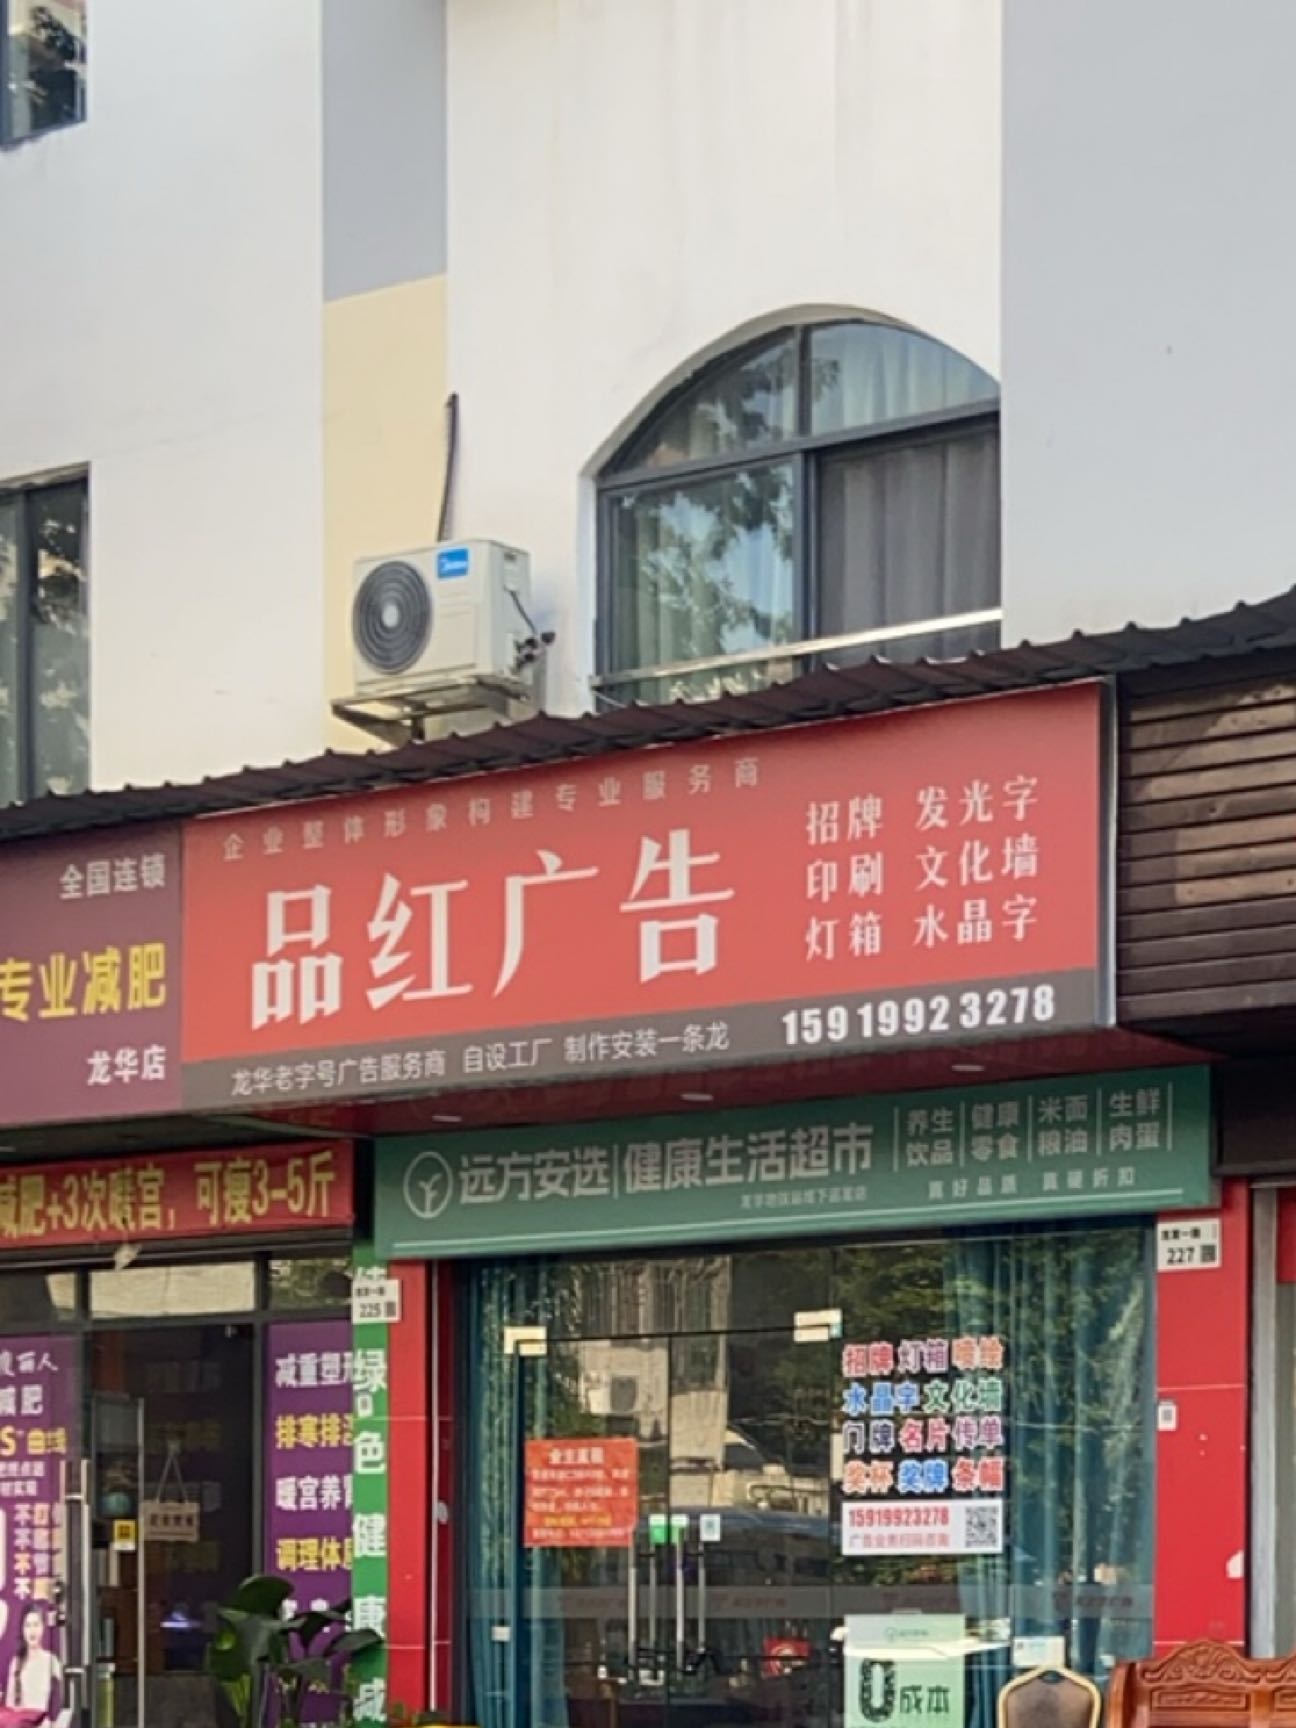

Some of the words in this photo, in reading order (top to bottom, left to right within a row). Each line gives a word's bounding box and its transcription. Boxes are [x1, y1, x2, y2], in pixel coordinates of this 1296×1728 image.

[222, 756, 758, 861] 企业整体形象构建专业服务商
[806, 796, 884, 846] 招牌
[914, 774, 1039, 831] 发光字
[59, 853, 166, 899] 全国连锁
[806, 851, 884, 904] 印刷
[914, 833, 1039, 891] 文化墙
[251, 828, 735, 1031] 品红广告
[806, 910, 884, 962] 灯箱
[913, 896, 1039, 949] 水晶字
[0, 942, 167, 1022] 专业减肥
[87, 1044, 166, 1086] 龙华店
[231, 1049, 446, 1096] 龙华老字号广告服务商
[462, 1037, 553, 1074] 自设工厂
[564, 1021, 730, 1063] 制作安装一条龙
[907, 1106, 954, 1137] 养生
[1038, 1094, 1089, 1124] 米面
[1109, 1087, 1161, 1118] 生鲜
[458, 1143, 609, 1205] 远方安选
[624, 1121, 874, 1193] 健康生活超市
[907, 1137, 954, 1168] 饮品
[1167, 1246, 1196, 1265] 227
[842, 1379, 919, 1418] 水晶字
[922, 1376, 1003, 1413] 文化墙
